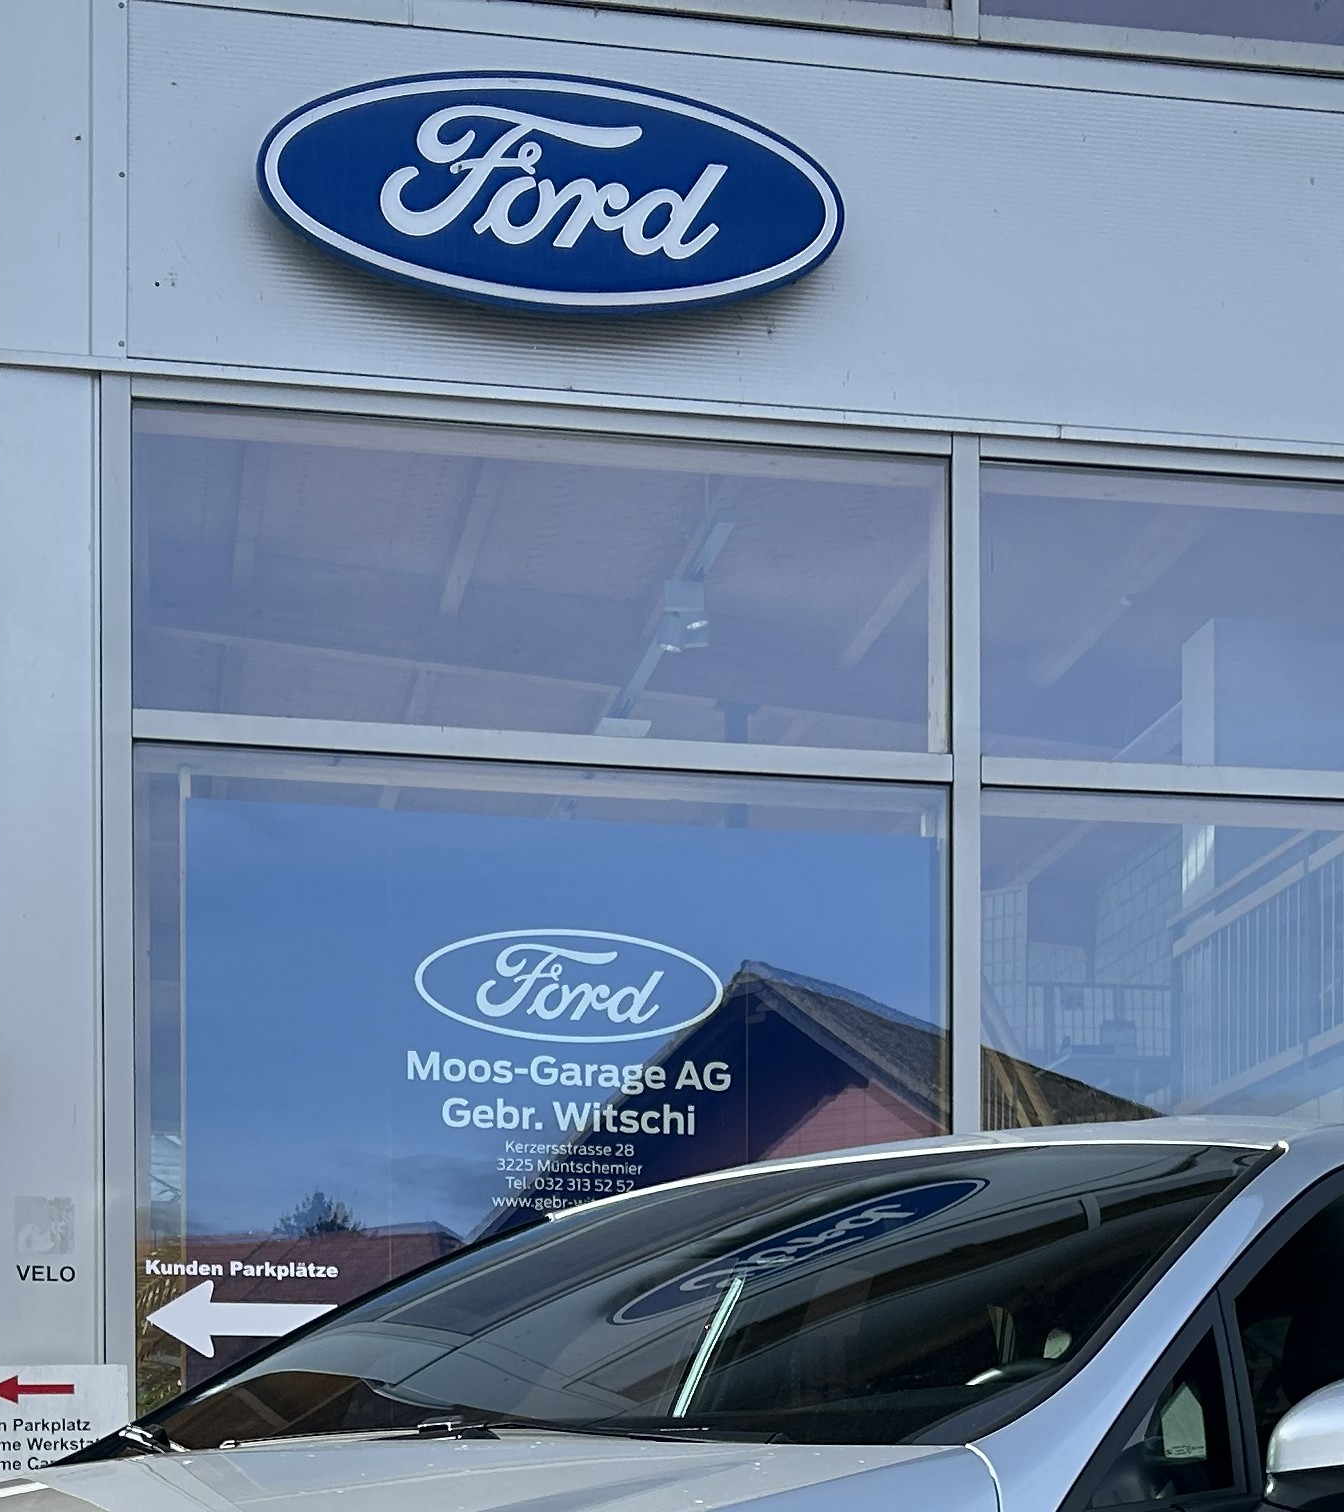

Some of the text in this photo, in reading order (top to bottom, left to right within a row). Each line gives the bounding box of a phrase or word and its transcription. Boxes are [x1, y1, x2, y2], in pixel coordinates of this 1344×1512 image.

[379, 104, 729, 260] Ford
[476, 943, 665, 1025] Ford
[406, 1050, 732, 1096] Moos-Garage AG
[441, 1097, 696, 1136] Gebr. Witschi
[505, 1140, 635, 1157] Kerzersstrasse 28
[496, 1158, 643, 1176] 3225 Müntschemier
[505, 1176, 635, 1193] Tel. 032 313 52 52
[16, 1265, 76, 1283] VELO
[145, 1260, 339, 1281] Kunden Parkplätze
[13, 1418, 91, 1435] Parkplatz
[27, 1437, 100, 1452] Werksta
